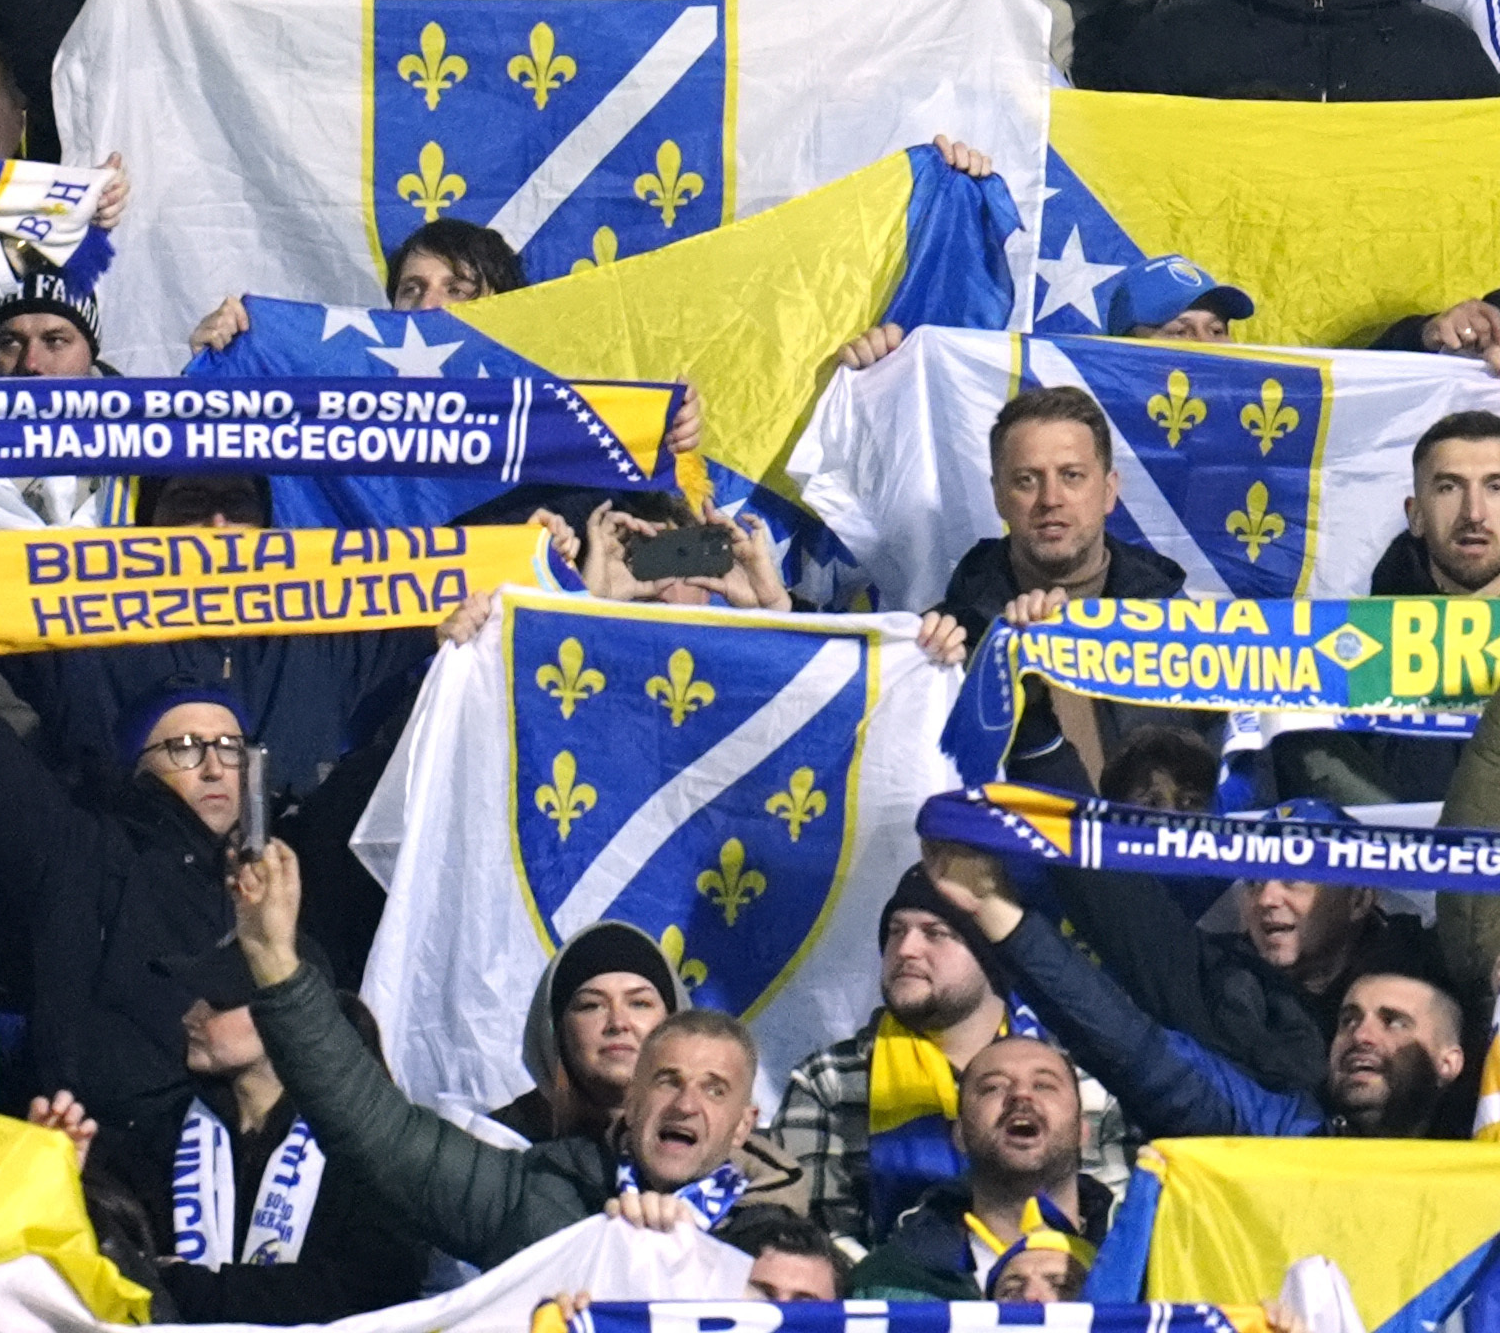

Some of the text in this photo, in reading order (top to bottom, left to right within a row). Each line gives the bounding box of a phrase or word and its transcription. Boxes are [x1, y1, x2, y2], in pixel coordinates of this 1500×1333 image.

[143, 389, 302, 427] BOSNO,
[319, 391, 500, 425] BOSNO...
[186, 423, 492, 464] HERCEGOVINO
[24, 528, 468, 586] BOSNIA AND
[30, 569, 469, 637] HERZEGOVINA
[1043, 598, 1271, 636] OSNA
[1020, 632, 1323, 692] HERCEGOVINA
